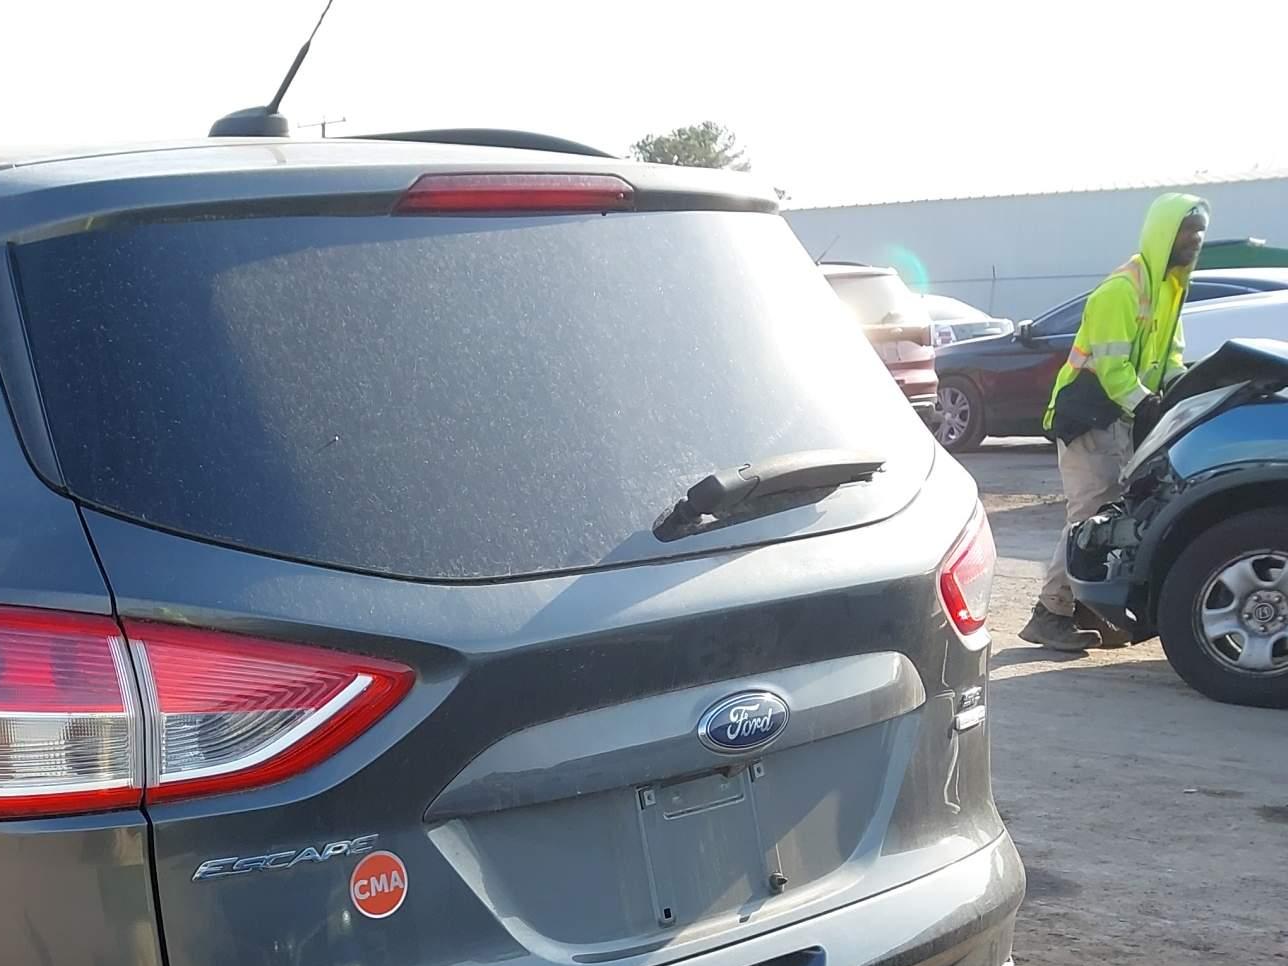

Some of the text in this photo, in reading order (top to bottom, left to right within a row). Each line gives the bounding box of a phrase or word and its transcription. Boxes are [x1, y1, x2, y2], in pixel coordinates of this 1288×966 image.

[726, 703, 773, 740] Ford
[191, 833, 379, 881] ESCAPE
[353, 870, 405, 900] CMA
